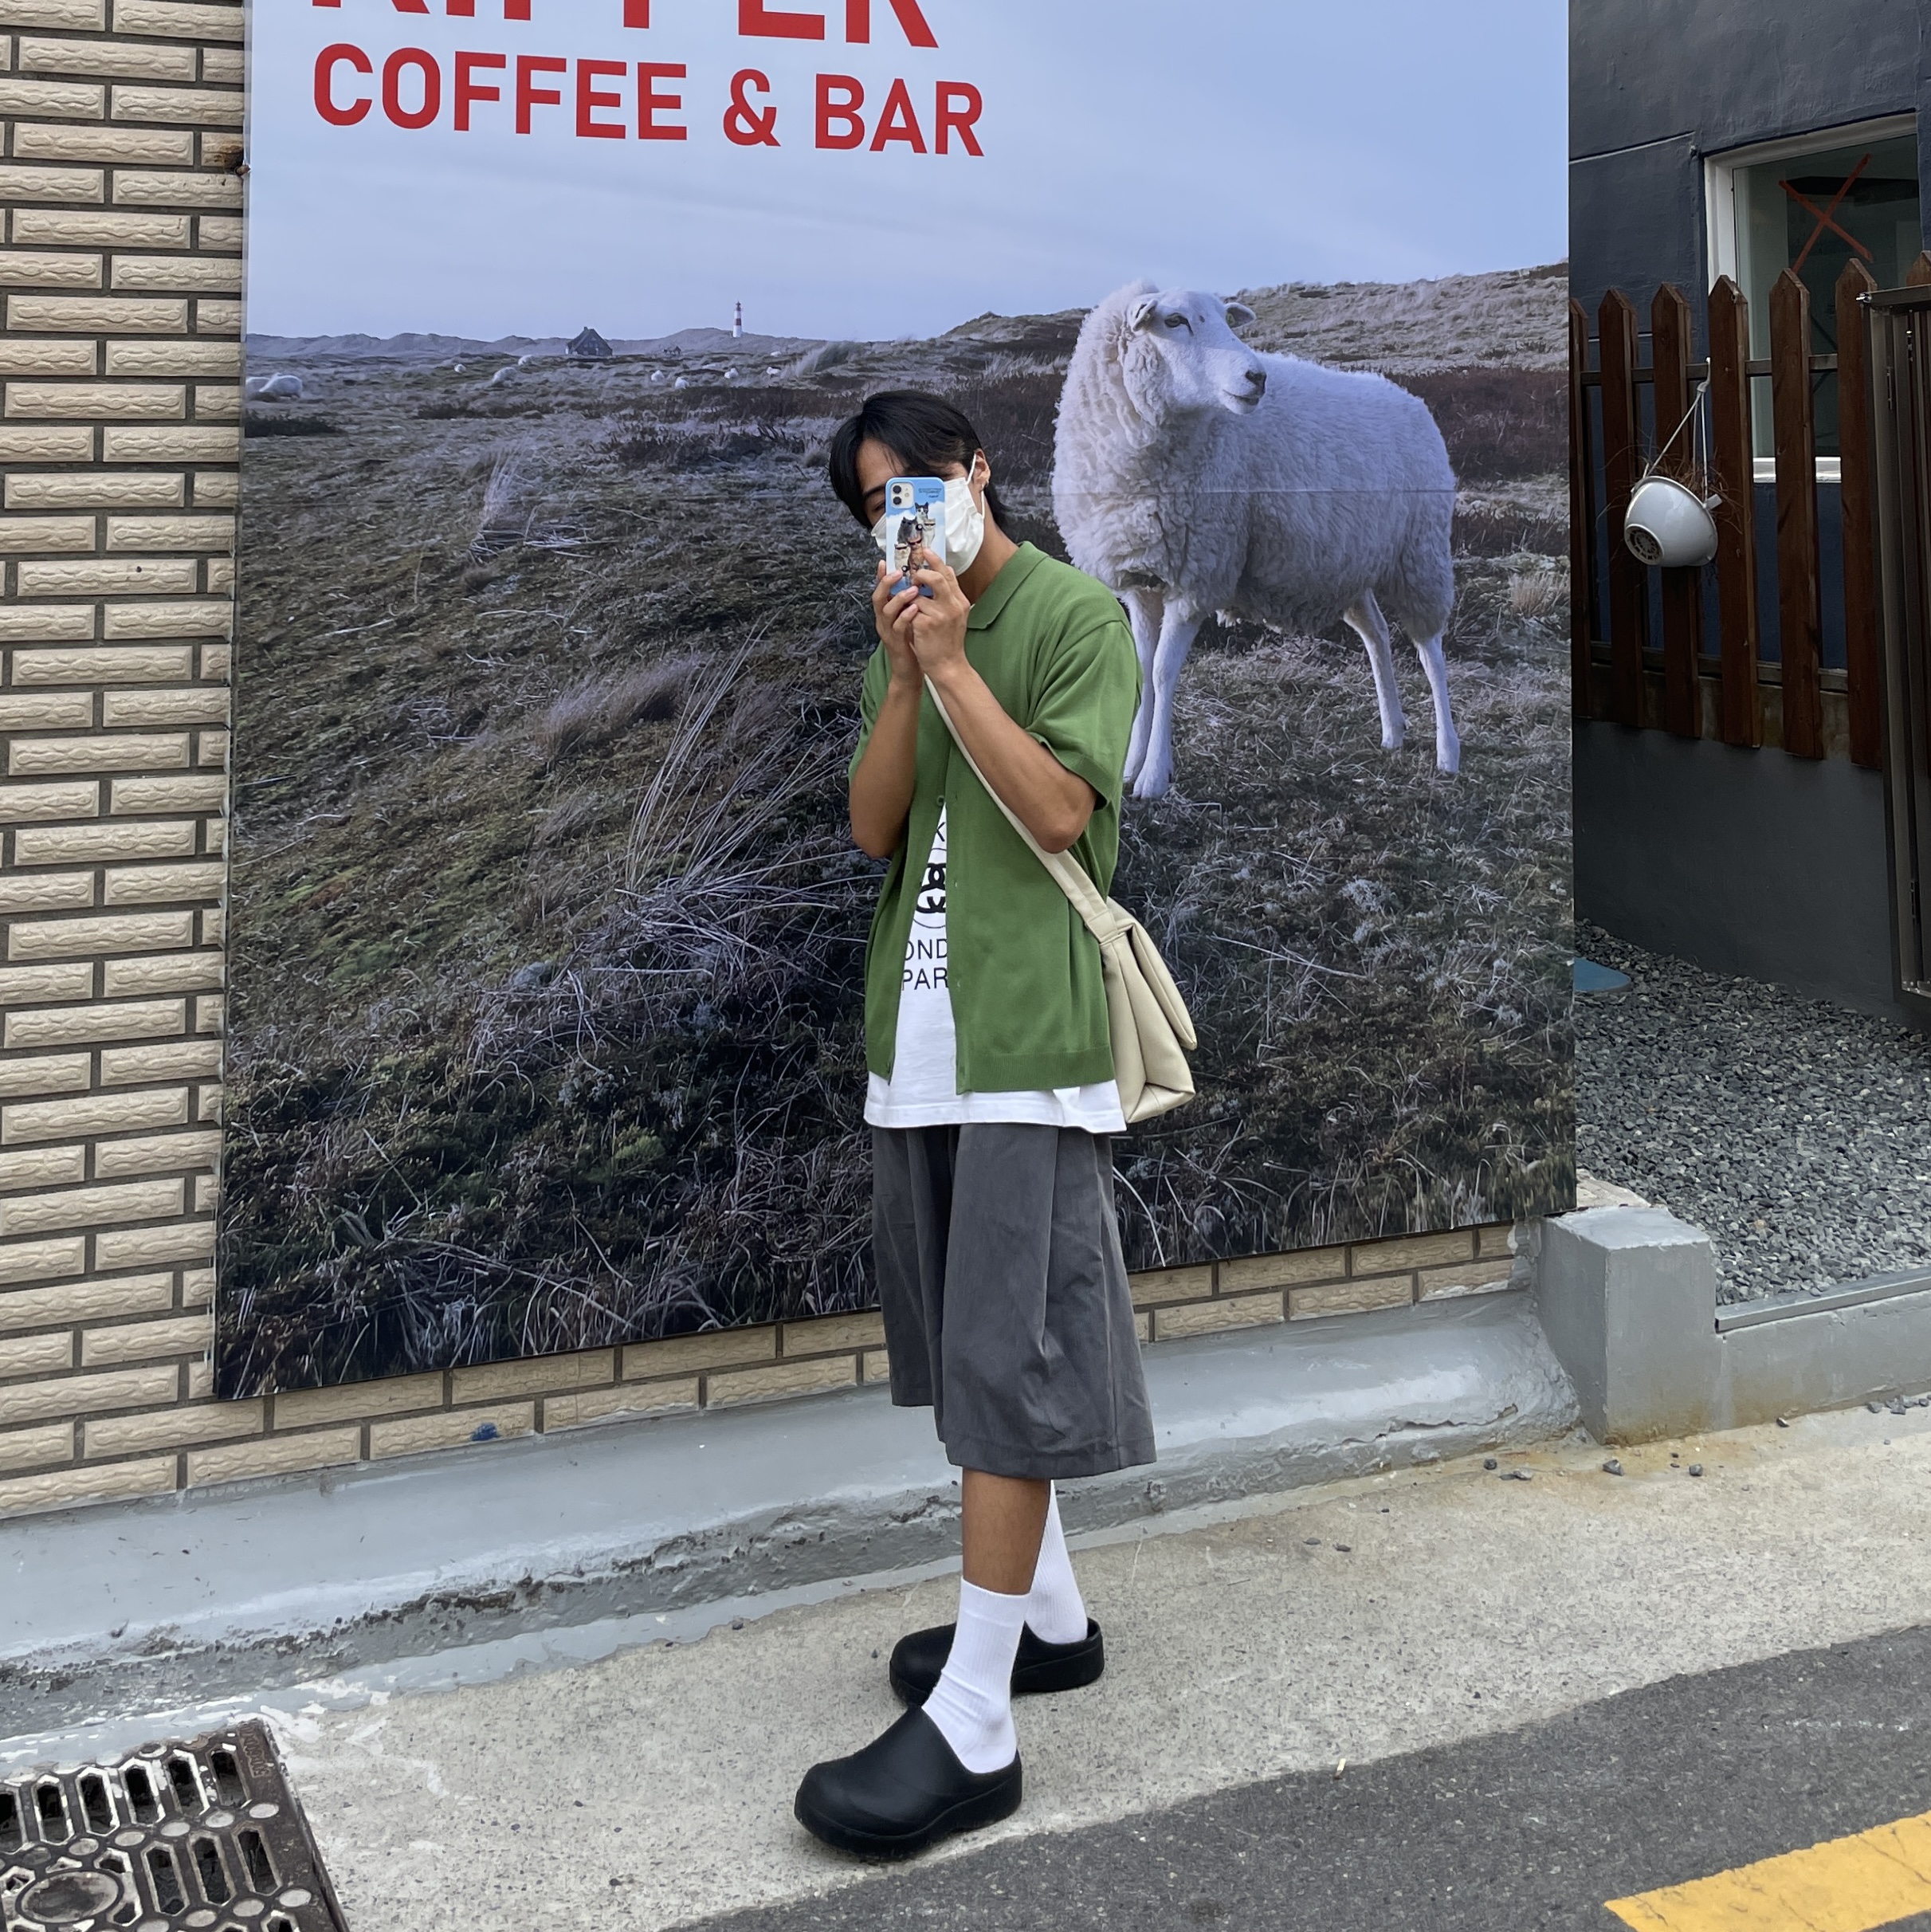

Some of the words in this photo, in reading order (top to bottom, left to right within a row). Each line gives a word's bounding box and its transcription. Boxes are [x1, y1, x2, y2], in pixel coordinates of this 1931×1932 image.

[314, 43, 687, 140] COFFEE
[723, 69, 780, 147] &
[815, 73, 984, 157] BAR
